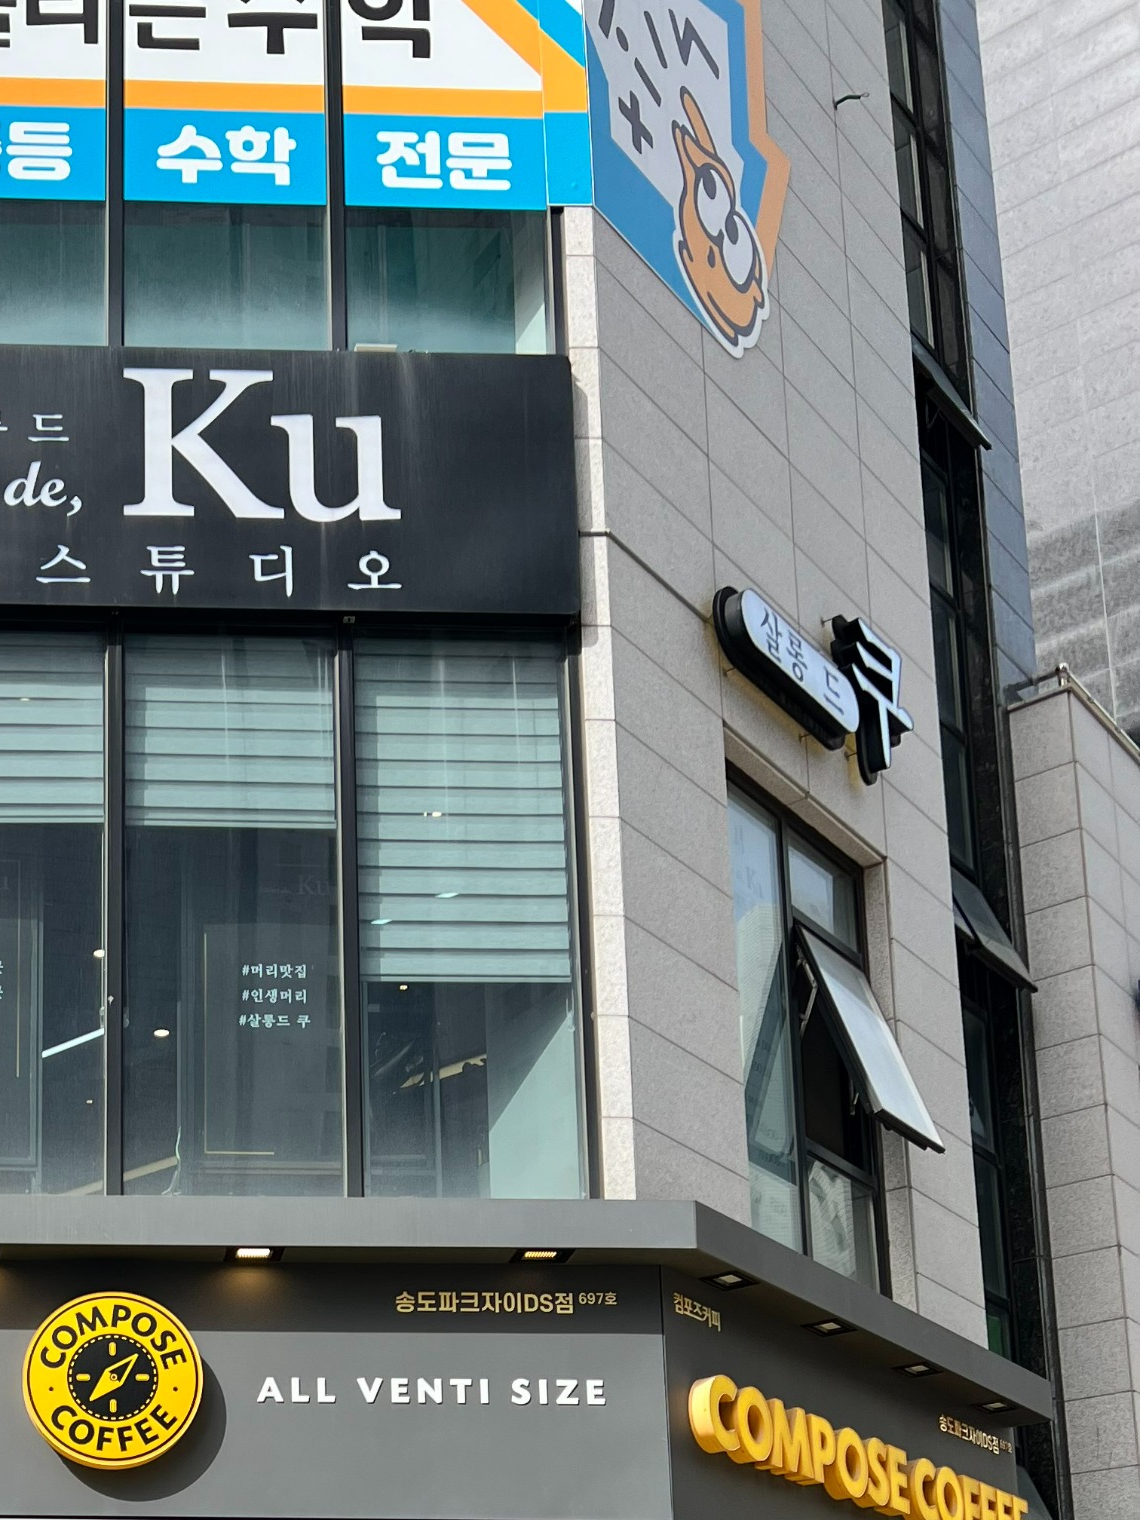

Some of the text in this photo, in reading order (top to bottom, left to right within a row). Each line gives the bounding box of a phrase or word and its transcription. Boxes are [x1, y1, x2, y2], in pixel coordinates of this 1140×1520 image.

[156, 124, 297, 187] 수학
[376, 130, 512, 191] 전문
[27, 413, 69, 442] 드
[123, 368, 402, 523] Ku
[761, 607, 845, 716] 살롱 드
[241, 963, 308, 980] #머리맛집
[241, 988, 308, 1005] #인생머리
[296, 1013, 312, 1030] 쿠
[395, 1291, 618, 1314] 송도파크자이DS점 697호
[673, 1292, 721, 1332] 컴포즈커피
[40, 1304, 189, 1370] COMPOSE
[256, 1377, 609, 1405] ALL VENTI SIZE
[50, 1403, 179, 1453] COFFEE
[689, 1374, 910, 1517] COMPOSE
